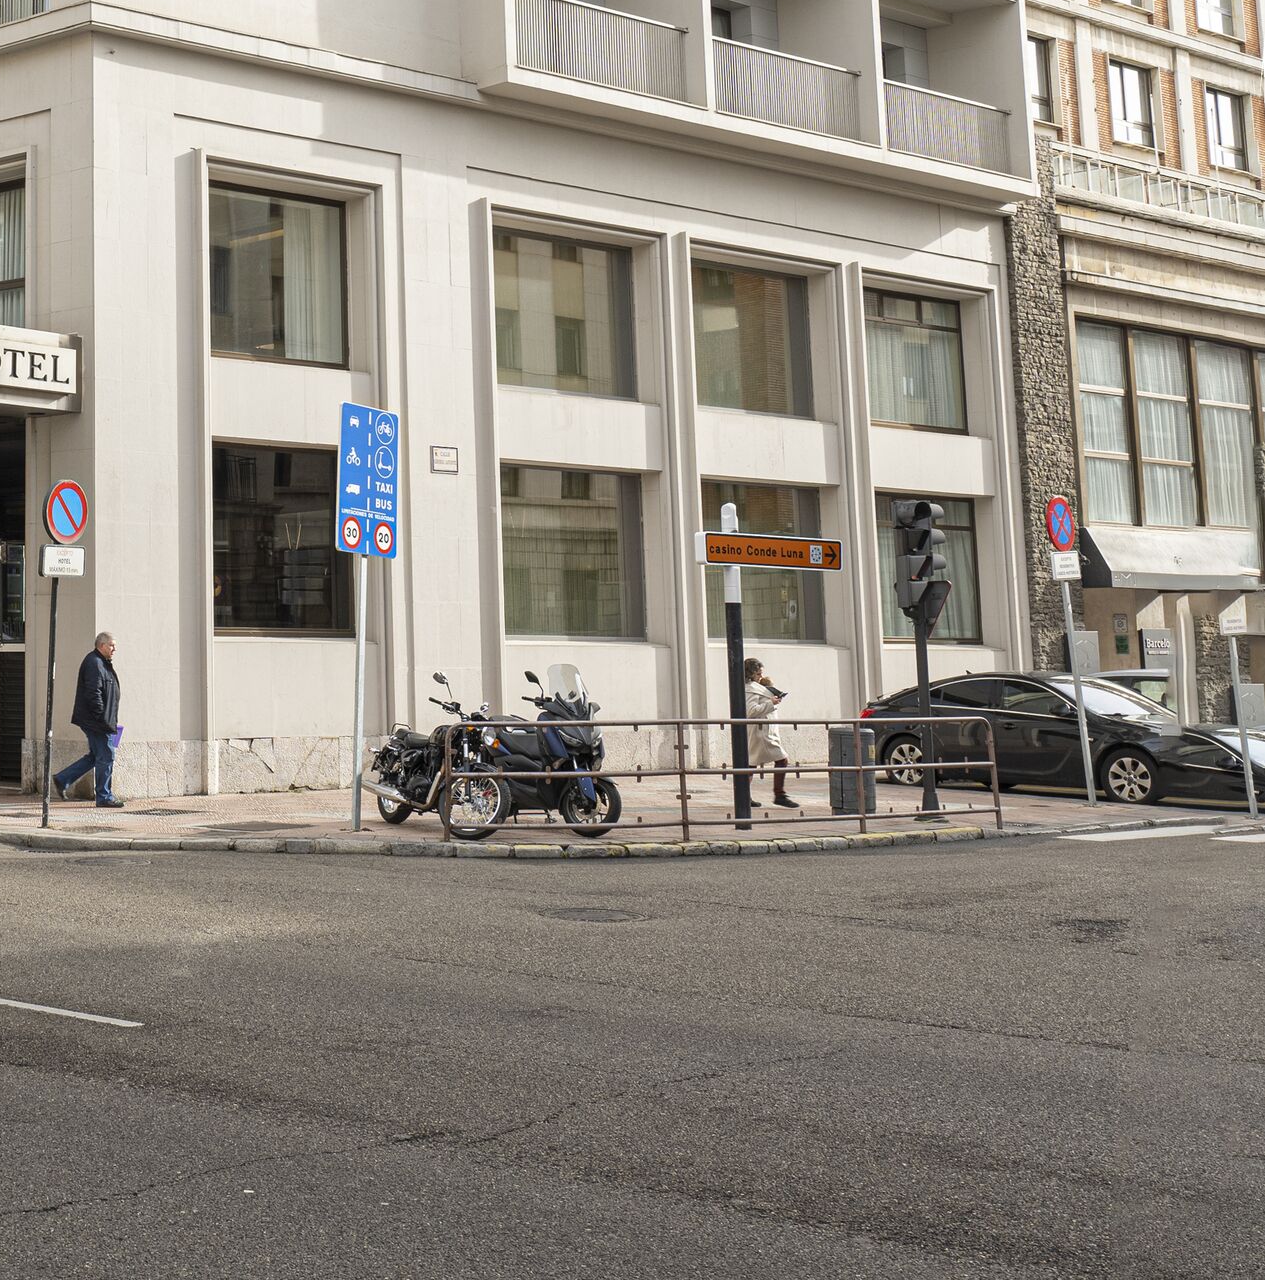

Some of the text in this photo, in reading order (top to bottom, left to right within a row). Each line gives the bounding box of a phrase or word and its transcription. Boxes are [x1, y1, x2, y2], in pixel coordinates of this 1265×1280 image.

[376, 481, 393, 494] TAXI
[376, 498, 392, 510] BUS
[346, 527, 358, 539] 30
[378, 532, 390, 544] 20
[709, 543, 804, 559] casino Conde Luna
